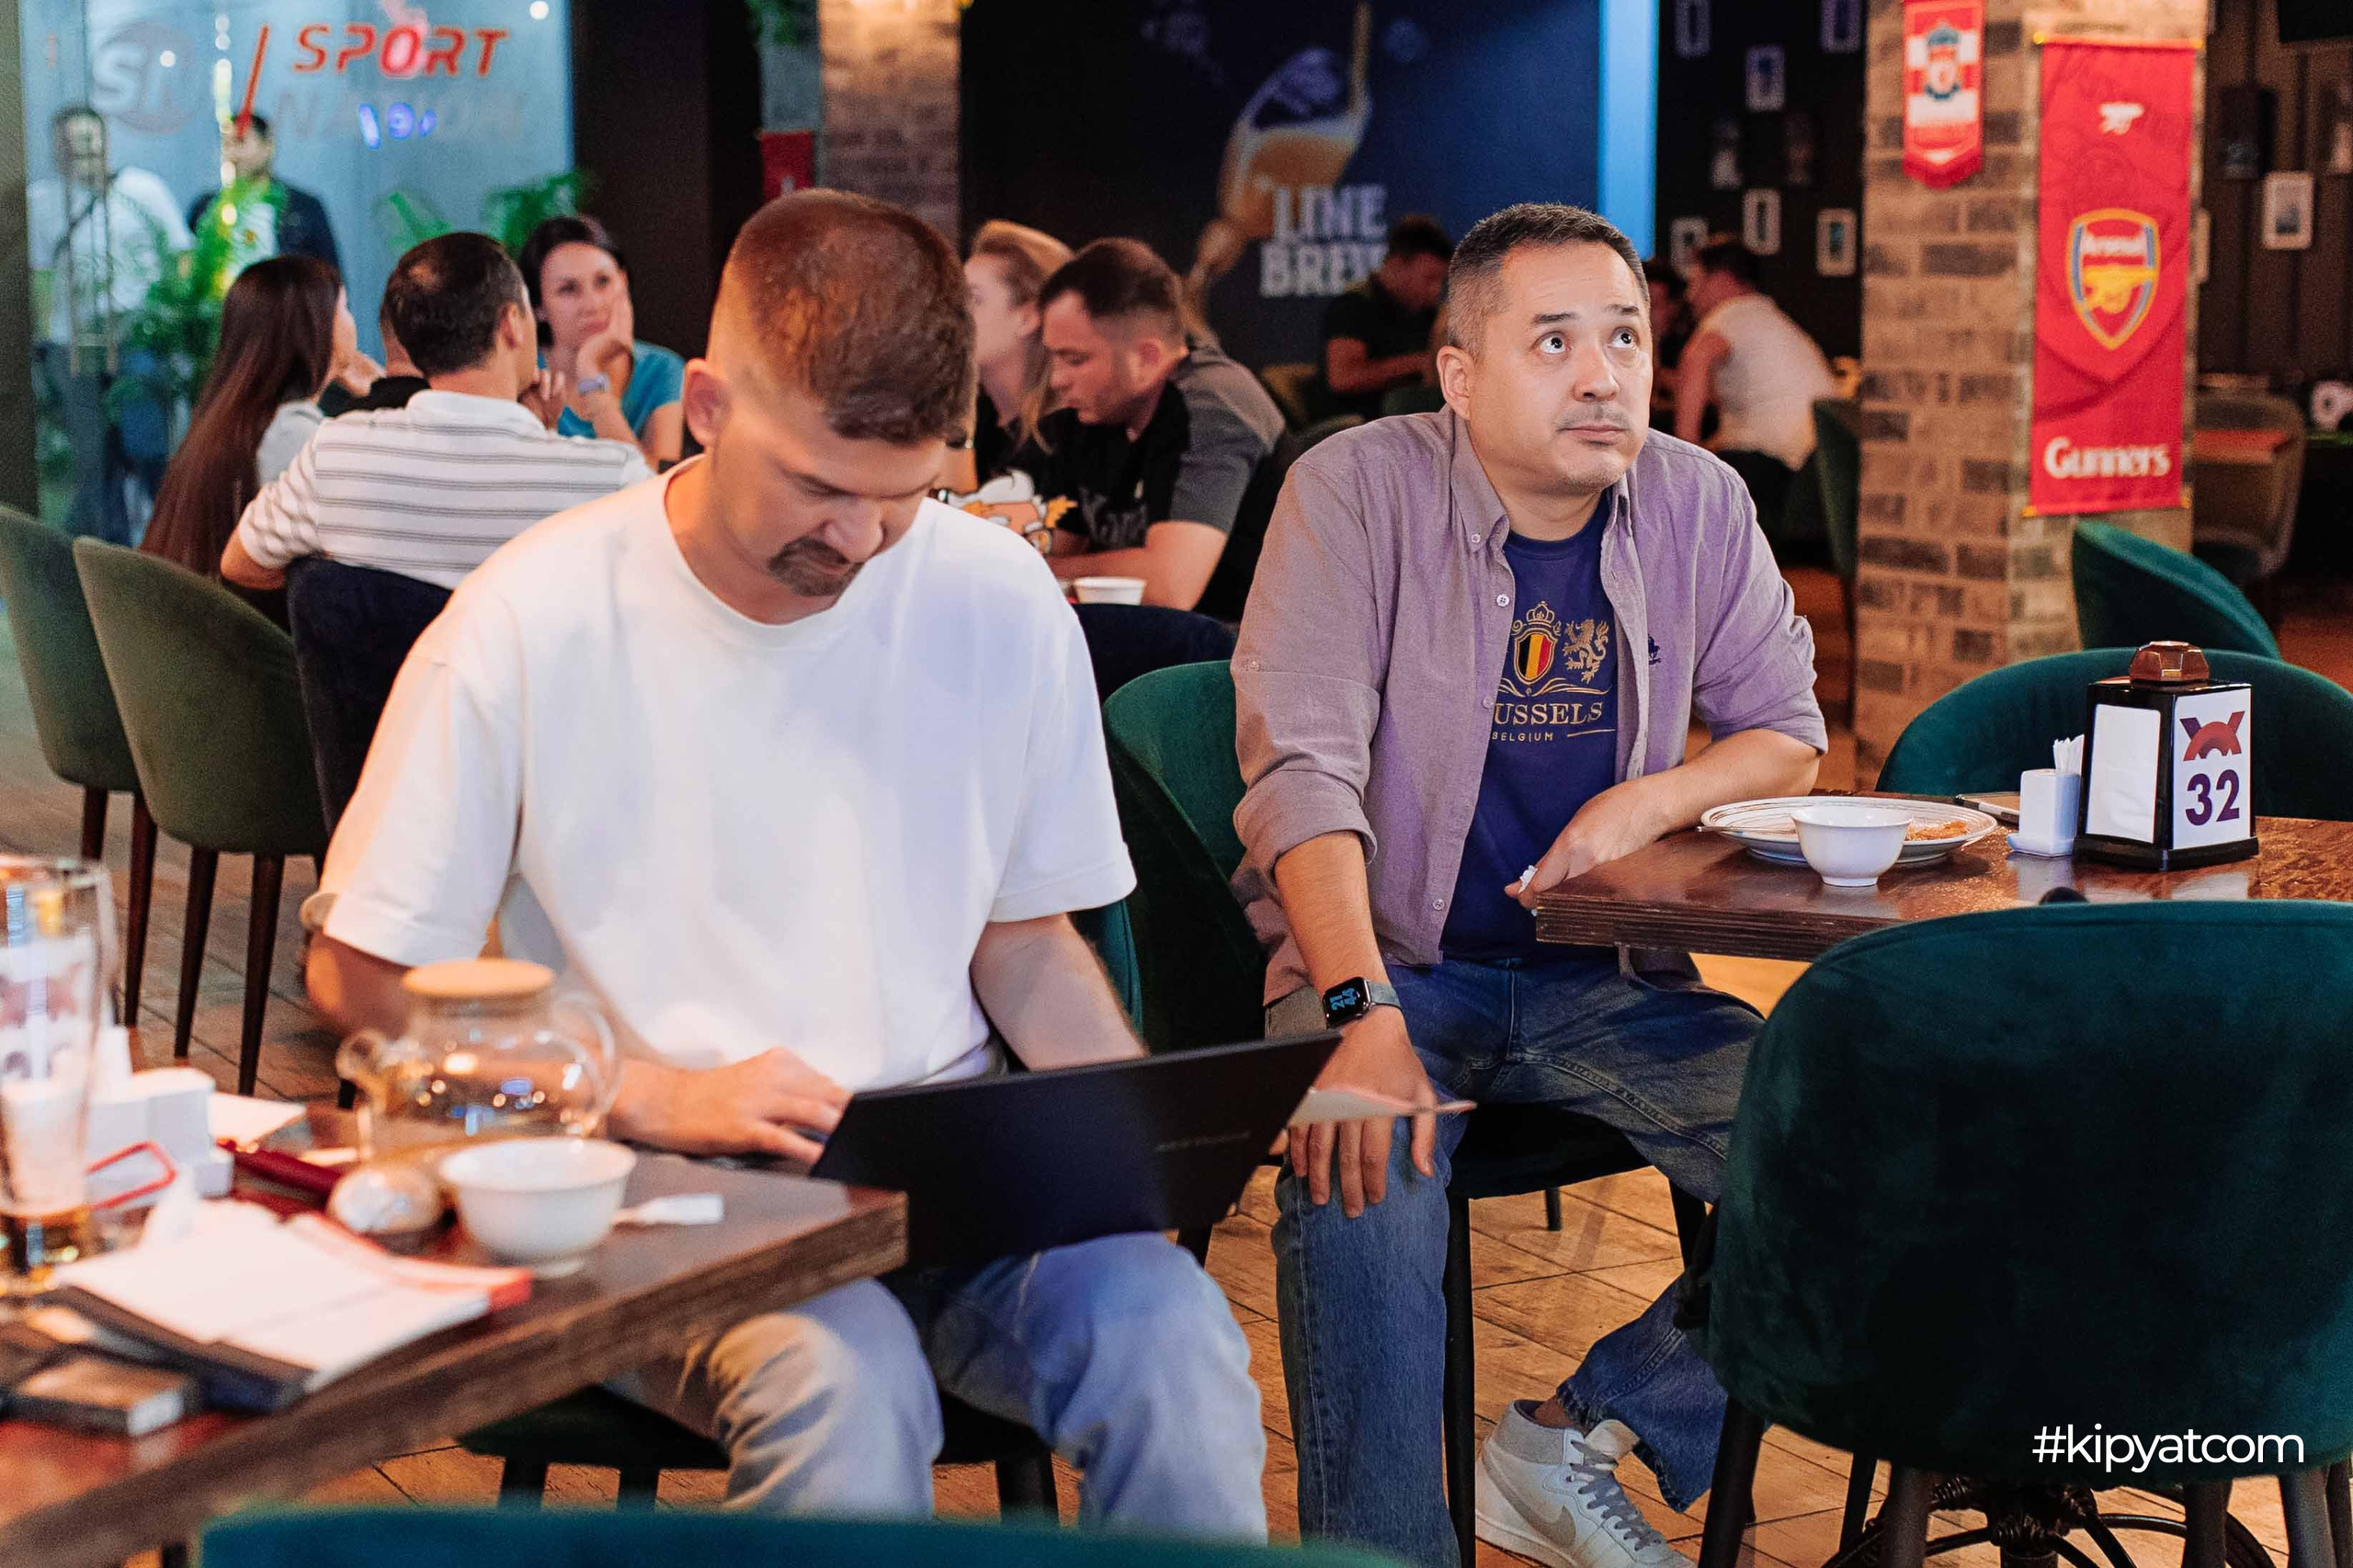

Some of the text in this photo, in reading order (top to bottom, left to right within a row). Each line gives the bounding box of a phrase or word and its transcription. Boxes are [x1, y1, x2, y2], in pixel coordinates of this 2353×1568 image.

[293, 24, 509, 79] SPORT
[2044, 437, 2171, 479] Gunners
[1494, 701, 1603, 725] USSELS
[1492, 732, 1553, 742] BELGIUM
[2185, 769, 2240, 826] 32
